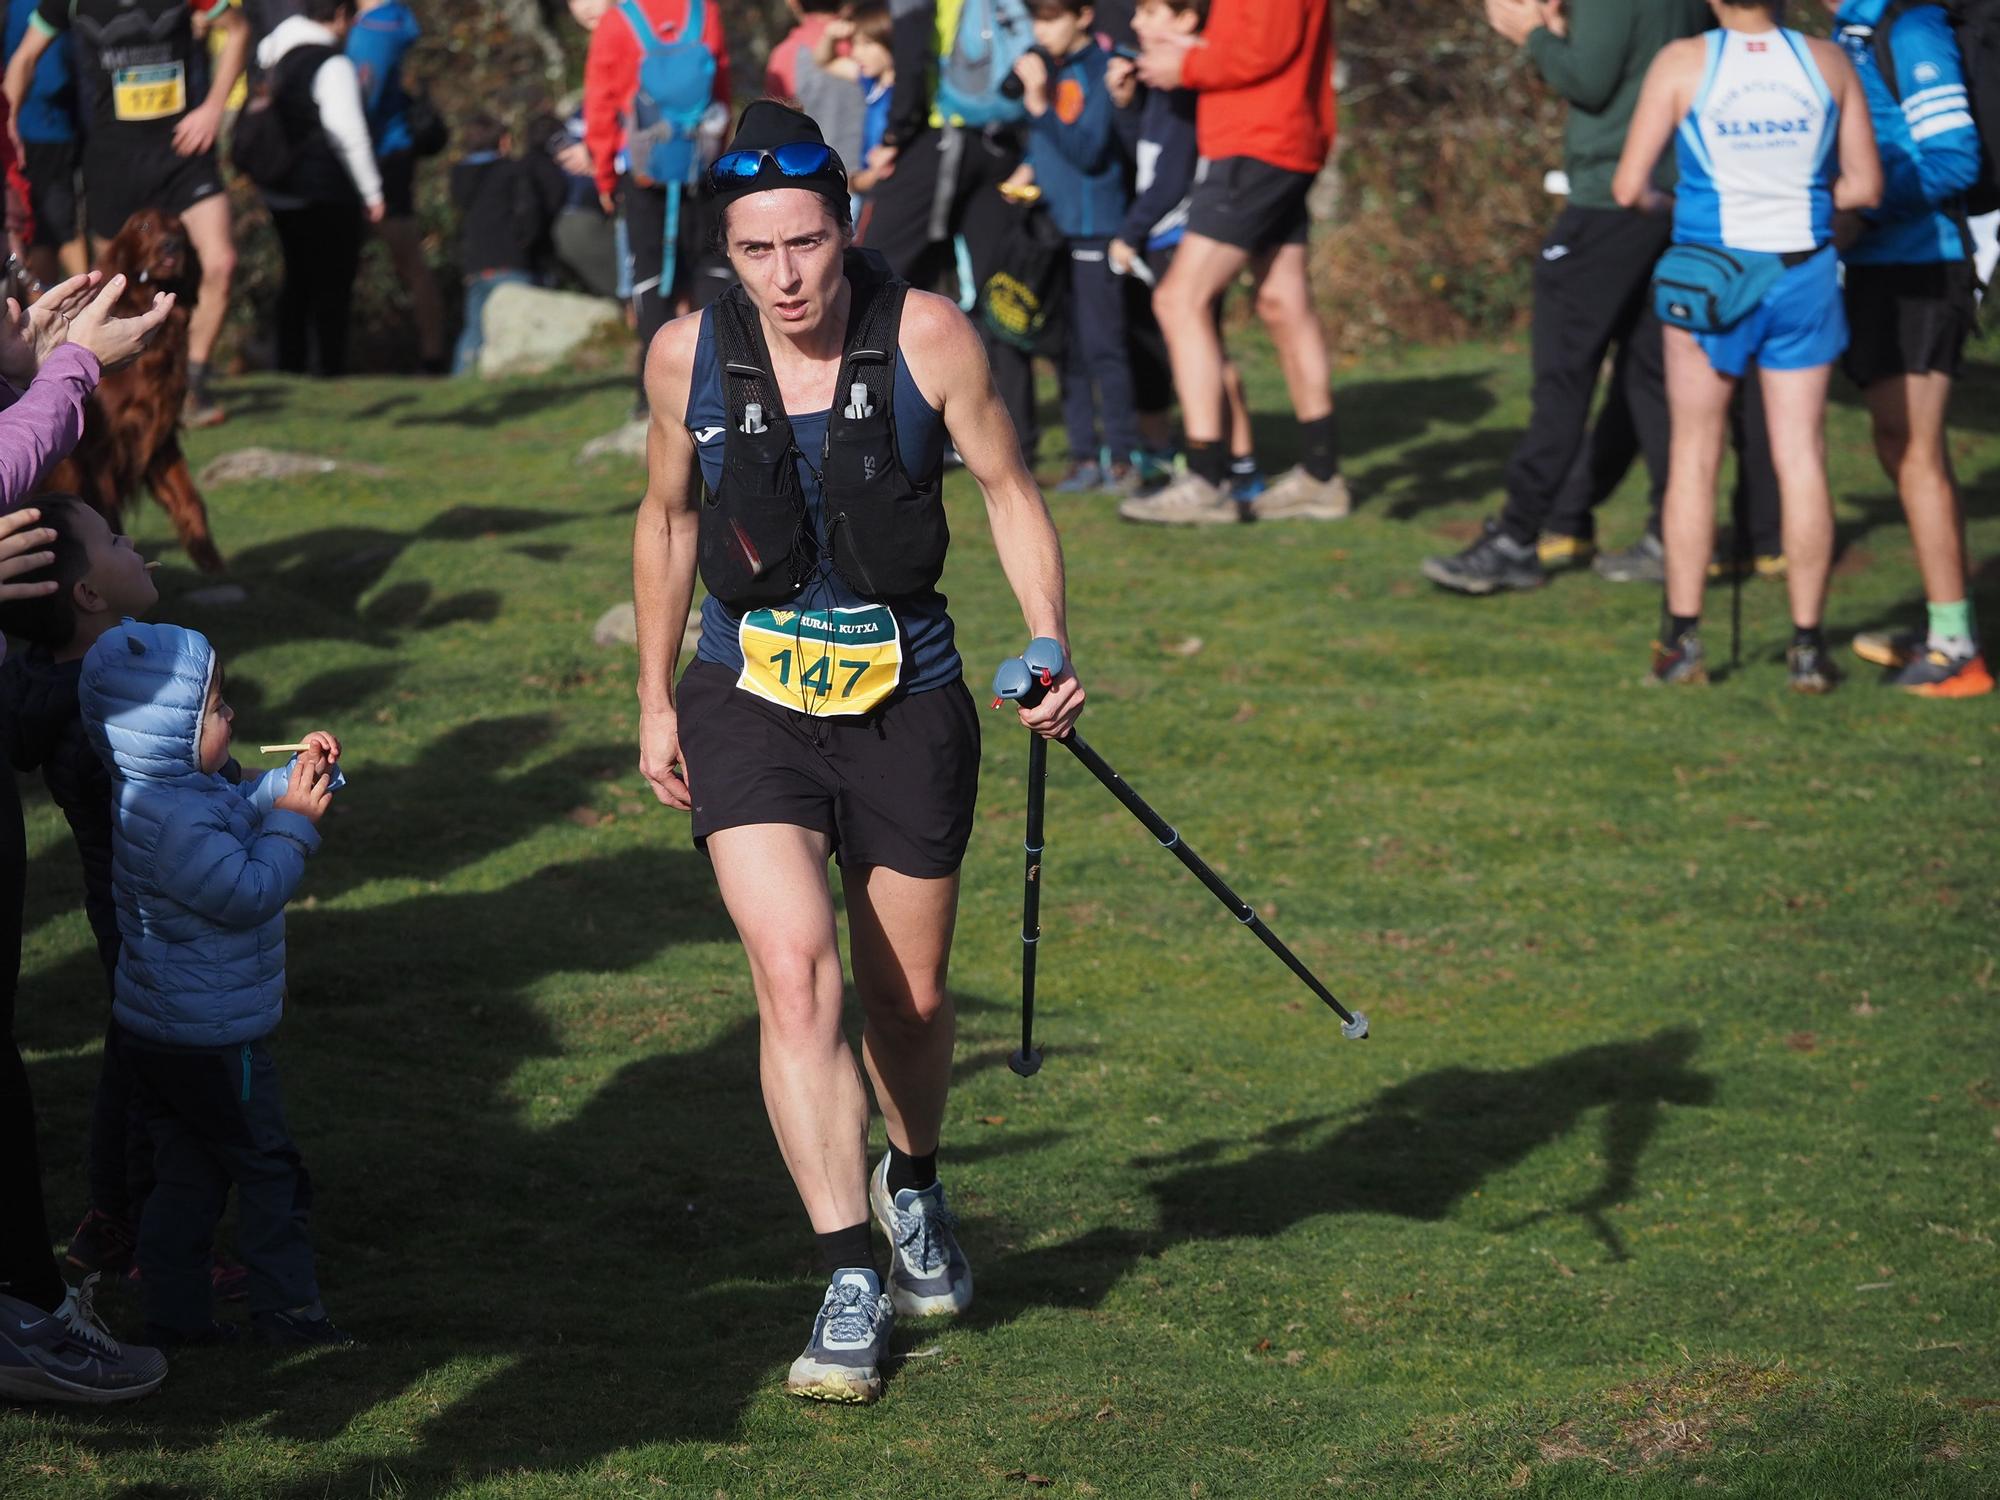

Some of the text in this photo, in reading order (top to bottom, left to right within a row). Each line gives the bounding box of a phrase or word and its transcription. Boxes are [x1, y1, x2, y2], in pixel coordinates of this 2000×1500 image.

[800, 615, 879, 634] RURAL KUTXA
[769, 649, 871, 698] 147
